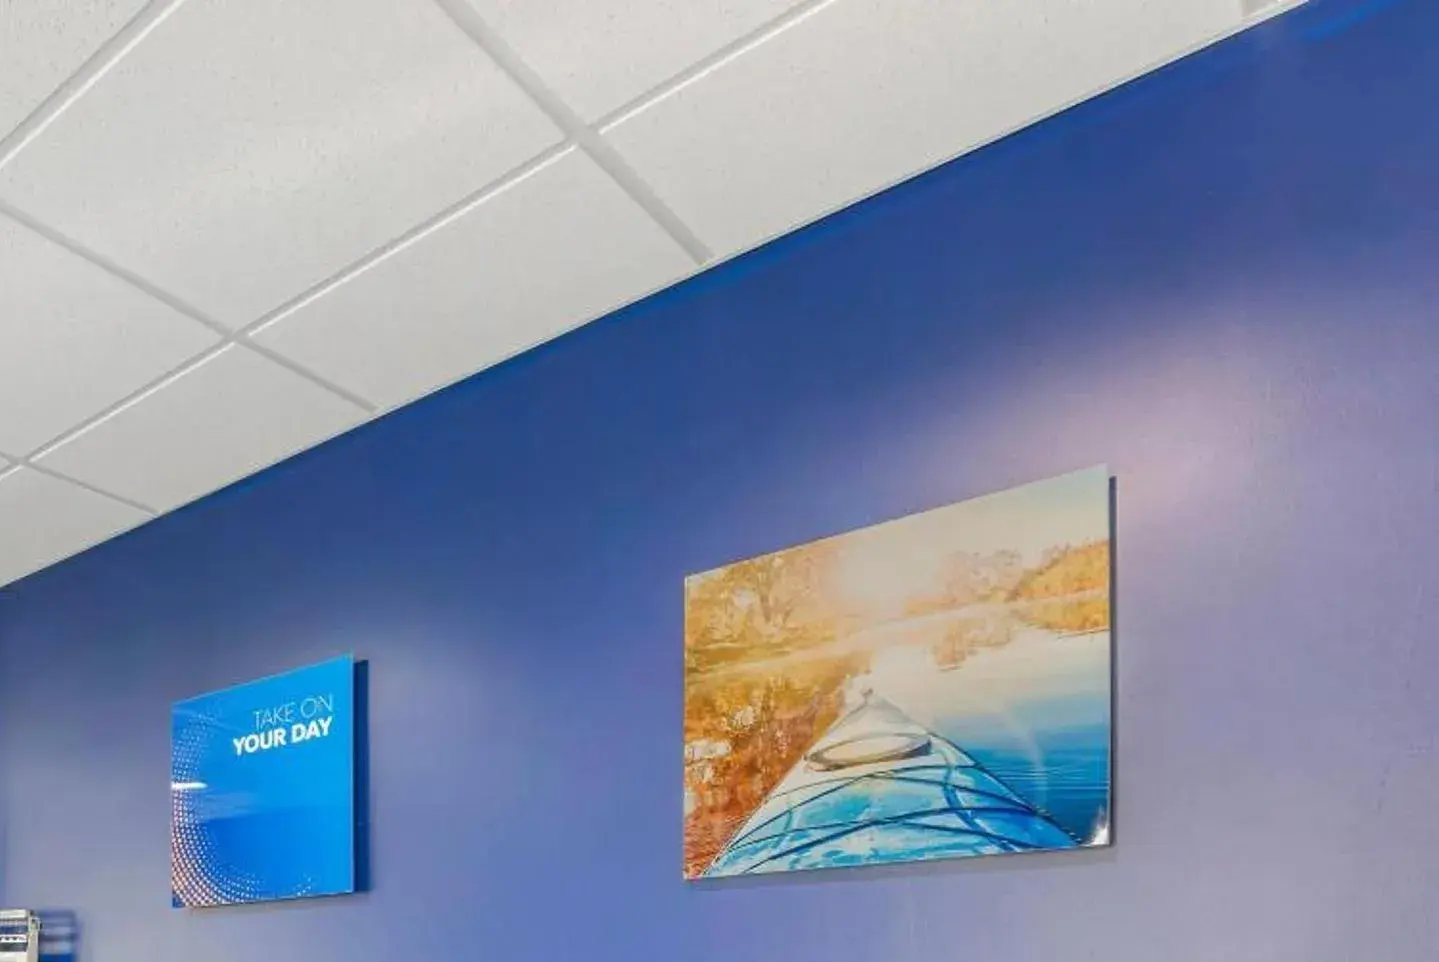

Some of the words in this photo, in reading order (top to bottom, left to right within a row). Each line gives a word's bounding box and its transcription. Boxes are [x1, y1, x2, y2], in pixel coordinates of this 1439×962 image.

[253, 702, 296, 731] TAKE
[300, 693, 333, 718] ON
[233, 727, 287, 756] YOUR
[291, 716, 332, 744] DAY
